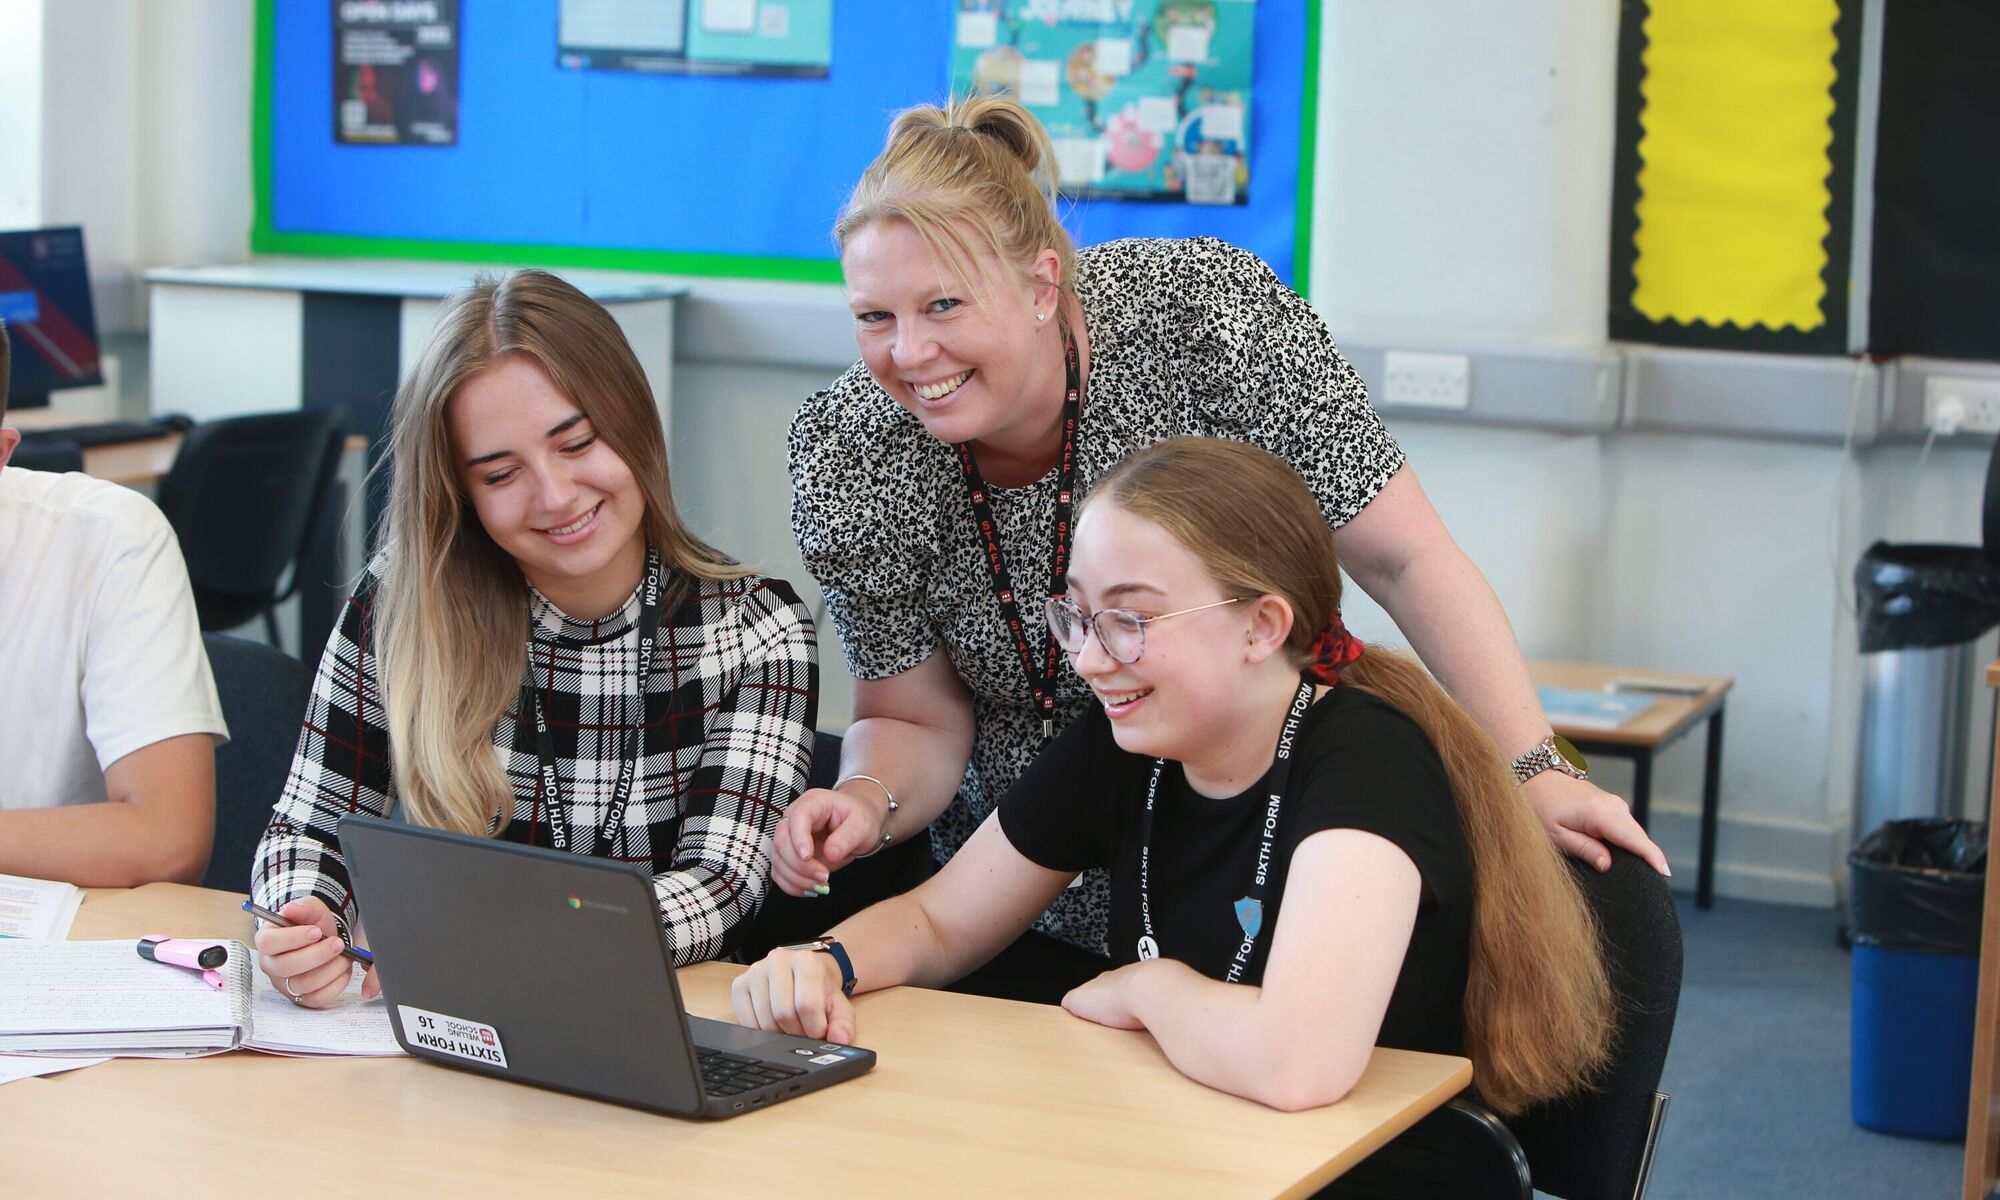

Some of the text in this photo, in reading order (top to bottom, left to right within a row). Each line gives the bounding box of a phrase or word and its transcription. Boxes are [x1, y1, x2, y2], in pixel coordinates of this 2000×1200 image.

[1063, 419, 1073, 473] STAFF
[982, 520, 1001, 574] STAFF
[1055, 522, 1066, 576] STAFF
[645, 567, 659, 606] FORM
[640, 637, 653, 676] SIXTH
[1010, 620, 1032, 672] STAFF
[1047, 635, 1056, 679] TAFF
[1278, 682, 1313, 760] SIXTH FORM
[542, 765, 566, 848] SIXTH FORM
[602, 759, 634, 840] SIXTH FORM
[1146, 767, 1161, 811] FORM
[1255, 794, 1281, 886] SIXTH FORM
[1141, 846, 1153, 936] SIXTH FORM
[416, 1032, 502, 1063] SIXTH FORM
[418, 1015, 435, 1029] 16
[445, 1020, 478, 1034] SCHOOL
[447, 1028, 481, 1042] WELLING
